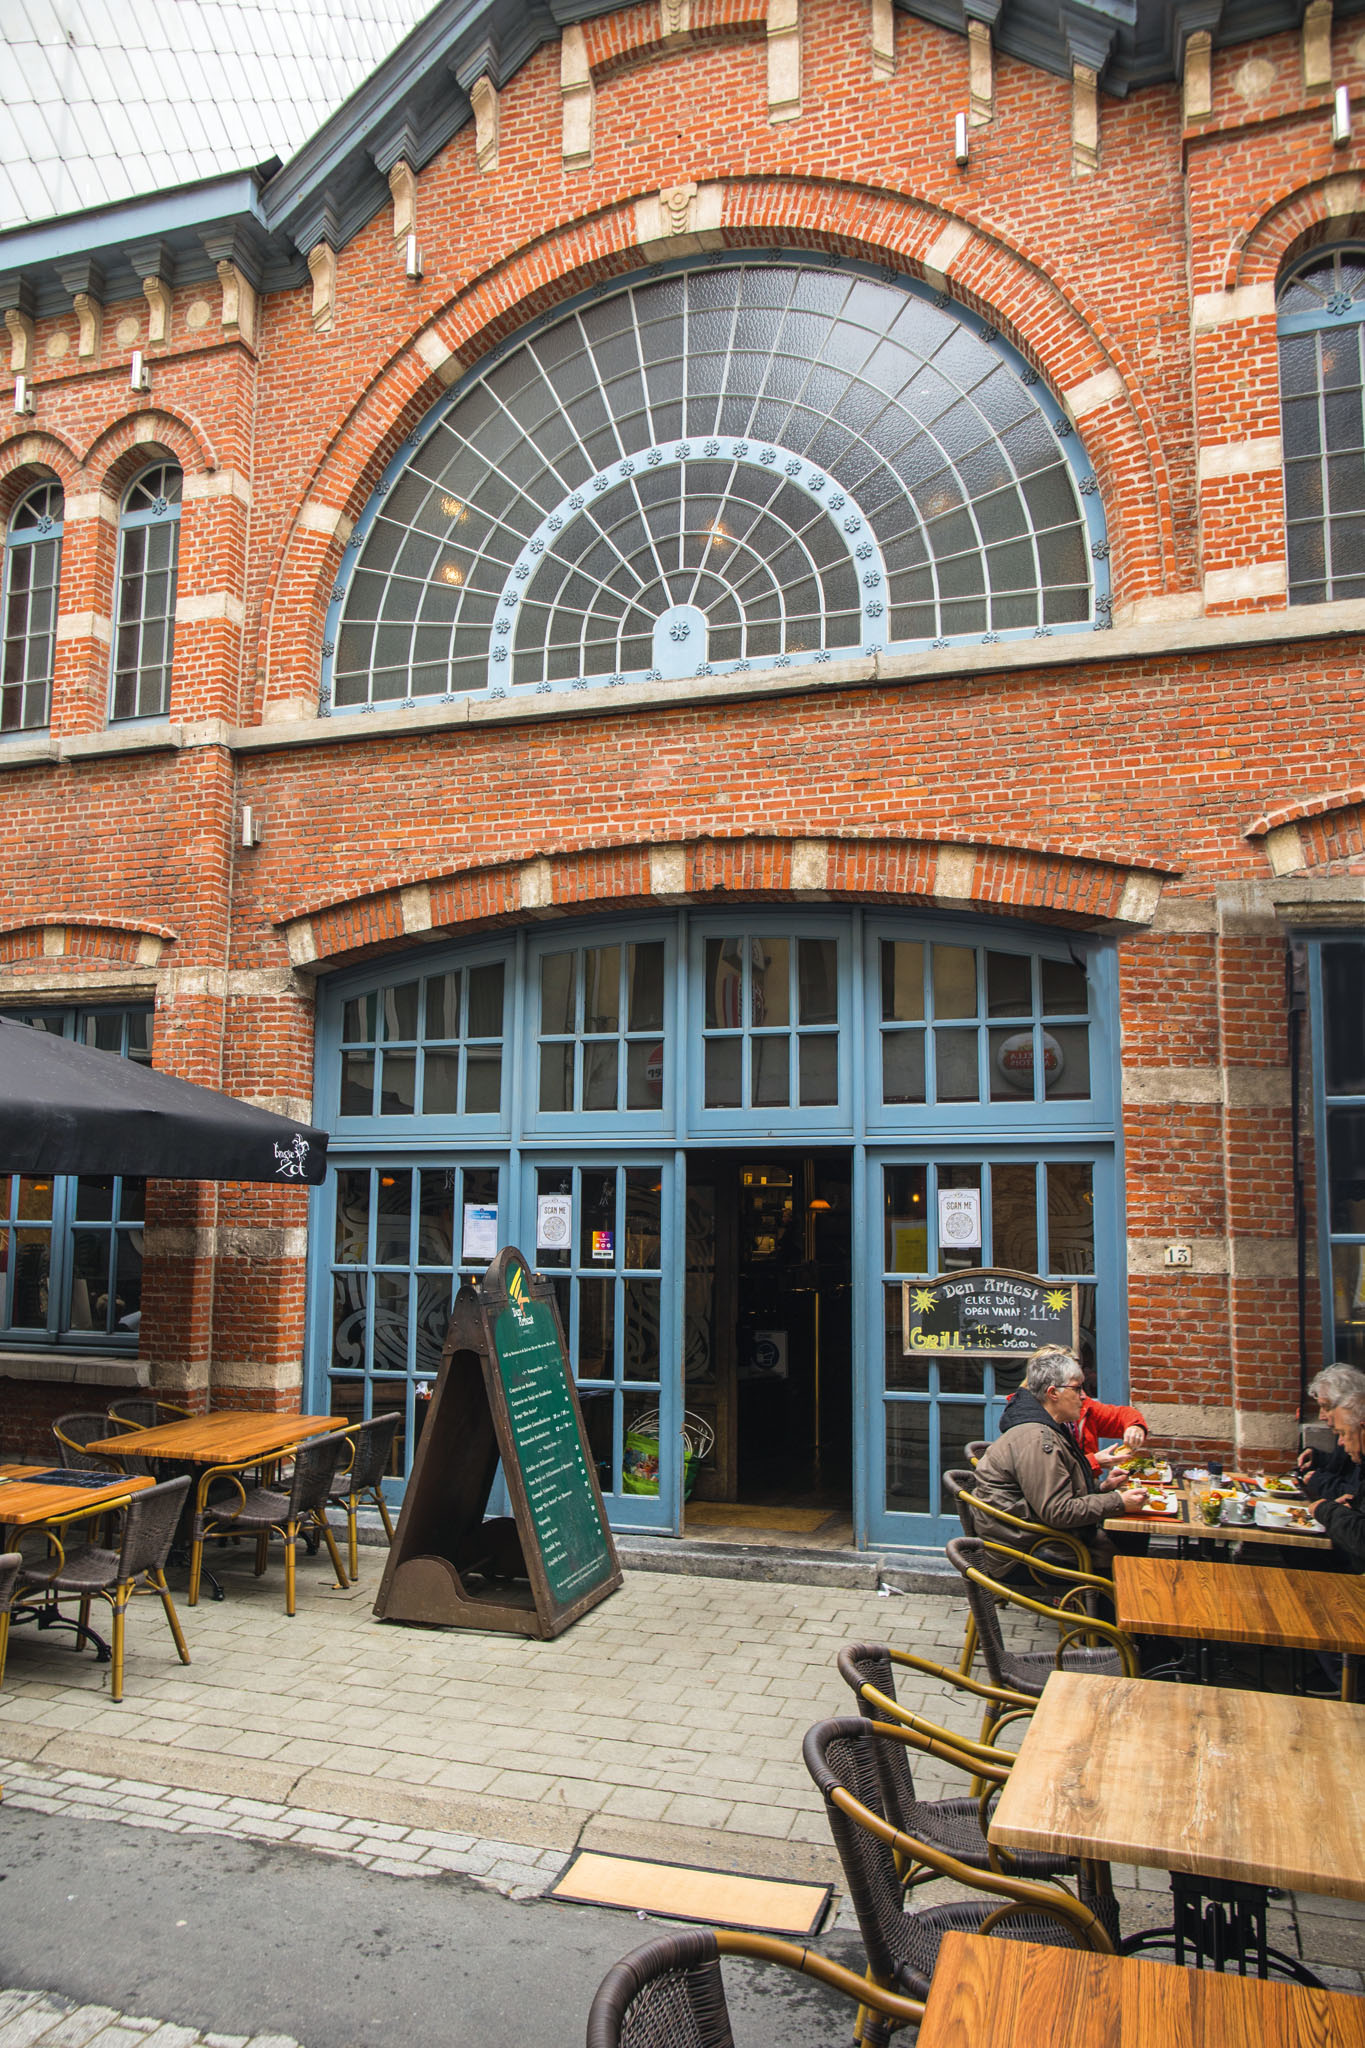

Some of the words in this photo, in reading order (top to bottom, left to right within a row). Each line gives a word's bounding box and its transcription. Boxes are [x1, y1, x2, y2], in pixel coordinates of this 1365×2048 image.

[946, 1201, 962, 1210] SCAN
[963, 1201, 972, 1210] ME
[544, 1206, 557, 1215] SCAN
[558, 1206, 566, 1215] ME
[1169, 1248, 1188, 1264] 13
[942, 1281, 975, 1299] Den
[984, 1278, 1039, 1301] Artiest
[964, 1296, 992, 1305] ELKE
[996, 1296, 1015, 1305] DAG
[964, 1307, 990, 1316] OPEN
